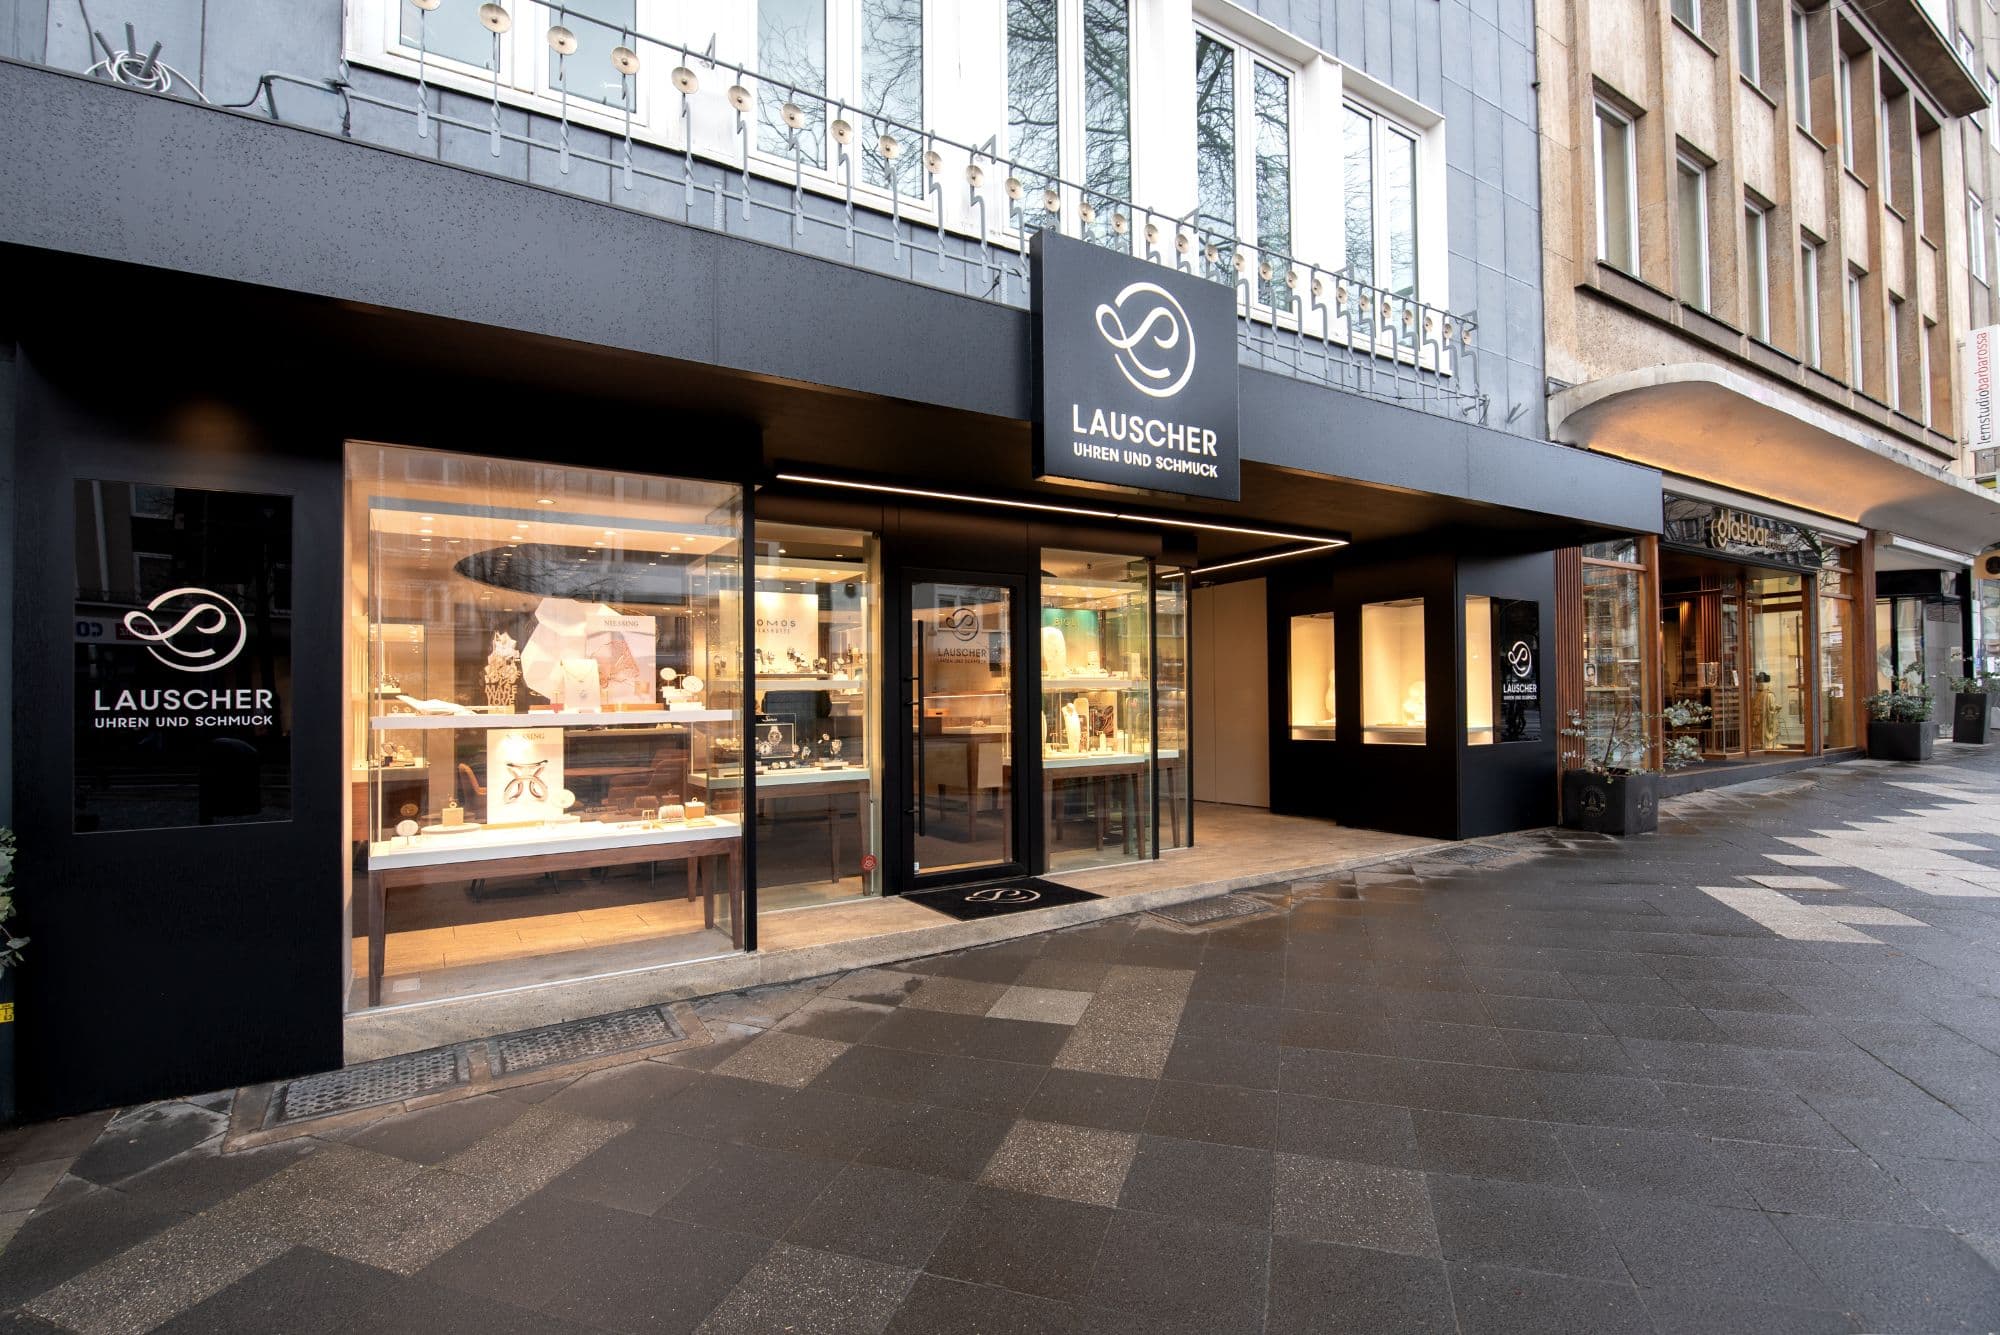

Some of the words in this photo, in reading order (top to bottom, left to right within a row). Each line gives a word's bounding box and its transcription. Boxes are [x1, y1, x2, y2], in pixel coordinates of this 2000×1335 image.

[1072, 403, 1218, 457] LAUSCHER
[1073, 442, 1120, 462] UHREN
[1123, 451, 1151, 468] UND
[1155, 455, 1218, 478] SCHMUCK
[756, 619, 796, 627] OMOS
[937, 648, 987, 657] LAUSCHER
[1503, 683, 1537, 693] LAUSCHER
[95, 689, 273, 711] LAUSCHER
[95, 717, 149, 728] UHREN
[156, 716, 189, 727] UND
[195, 715, 273, 726] SCHMUCK
